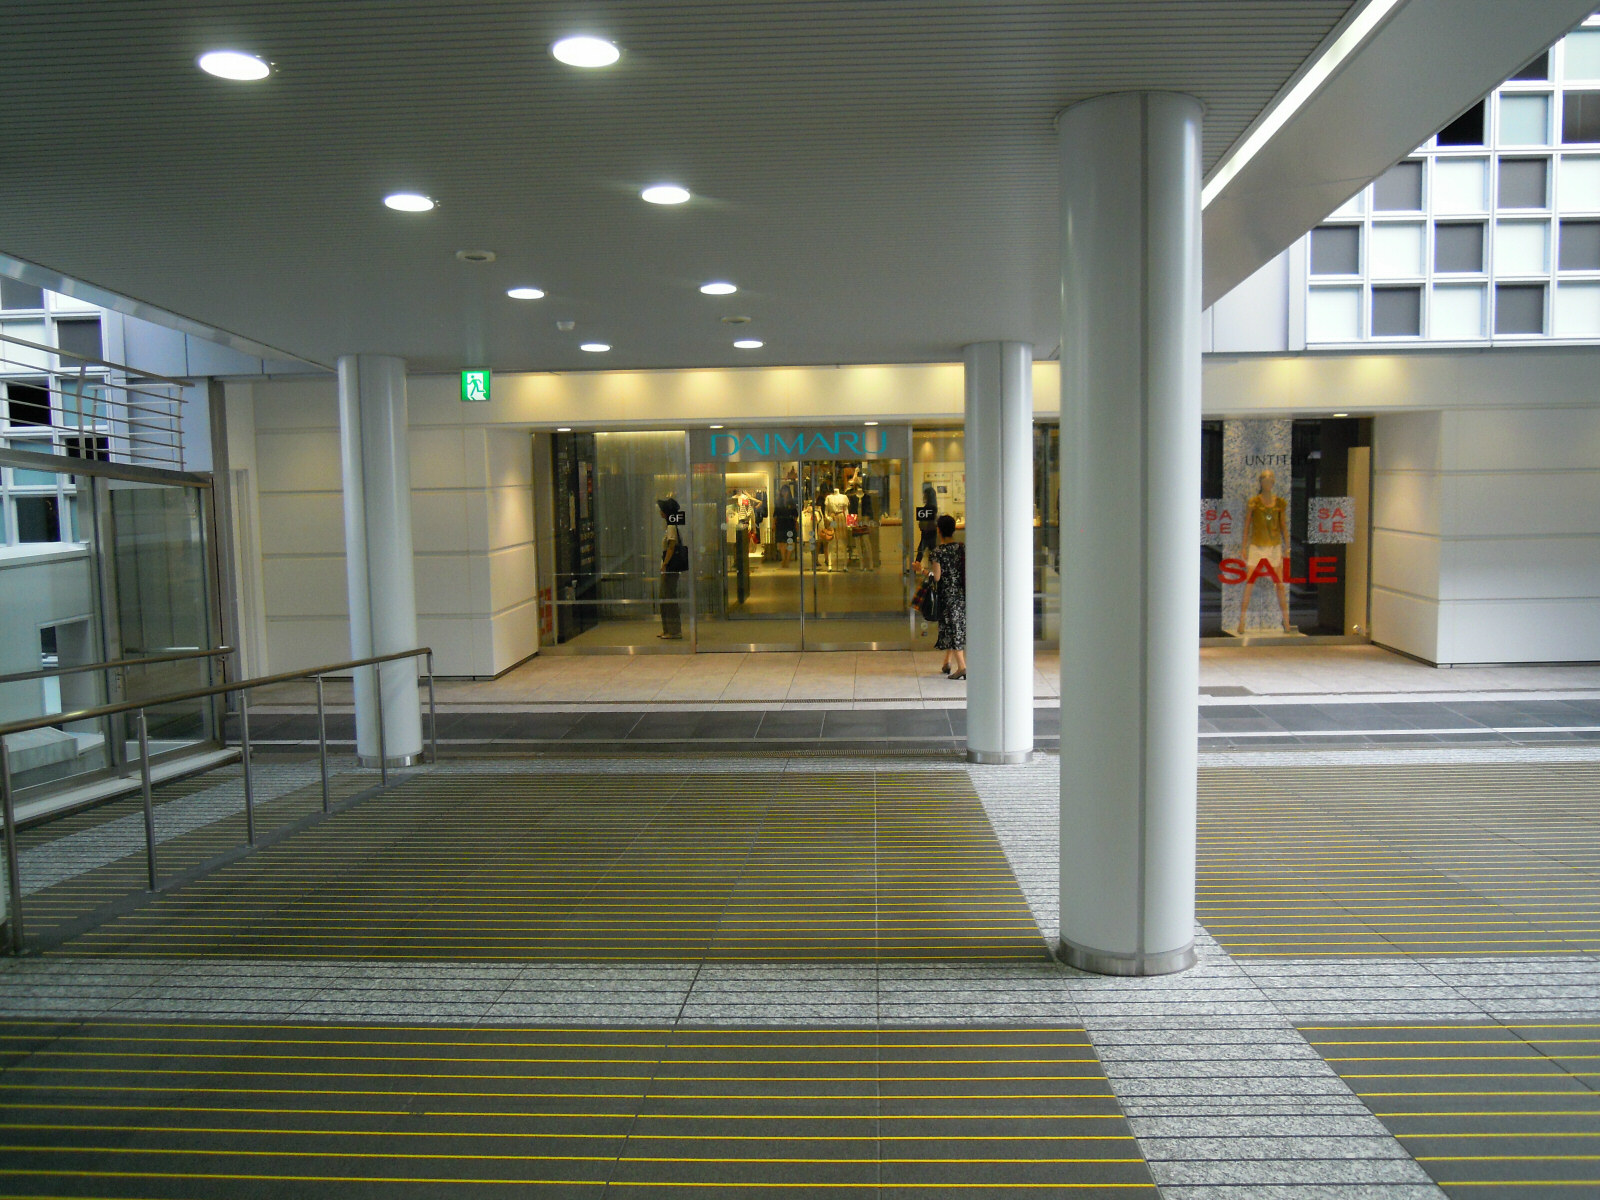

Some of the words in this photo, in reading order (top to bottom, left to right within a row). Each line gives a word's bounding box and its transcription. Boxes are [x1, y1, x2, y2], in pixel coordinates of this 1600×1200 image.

[710, 431, 888, 457] DAIMARU
[668, 514, 684, 523] 6F
[918, 509, 933, 519] 6F
[1205, 509, 1232, 521] SA
[1318, 507, 1346, 519] SA
[1205, 523, 1232, 535] LE
[1318, 522, 1345, 533] LE
[1217, 557, 1338, 585] SALE
